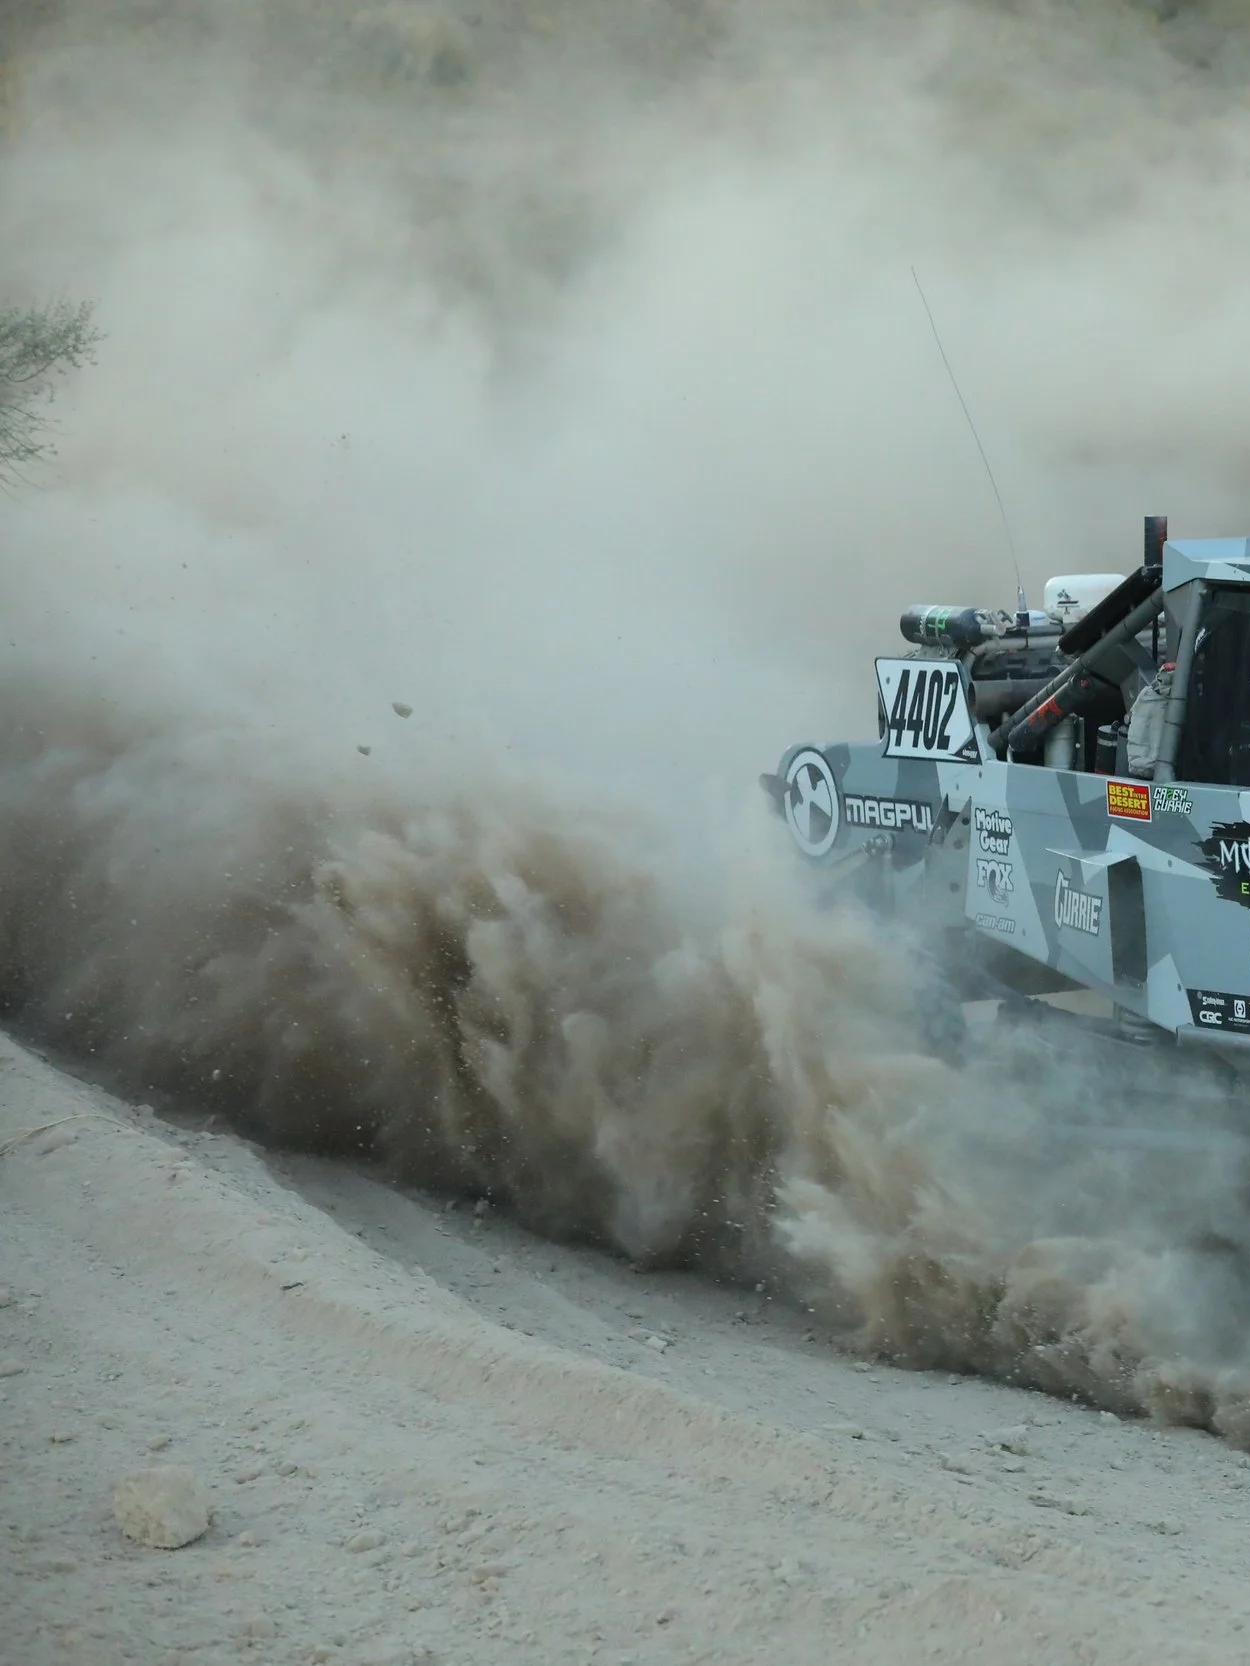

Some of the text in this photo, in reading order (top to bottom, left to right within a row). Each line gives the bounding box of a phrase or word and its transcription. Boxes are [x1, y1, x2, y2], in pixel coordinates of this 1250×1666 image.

[890, 669, 959, 750] 4402
[1109, 785, 1134, 797] BEST
[1109, 795, 1148, 809] DESERT
[845, 797, 937, 831] MAGPUL
[1154, 799, 1192, 814] CURRIE
[976, 809, 1012, 834] Motive
[980, 831, 1009, 855] Gear
[976, 858, 1014, 901] FOX
[976, 913, 1016, 933] can-am
[1199, 1011, 1222, 1024] CRC
